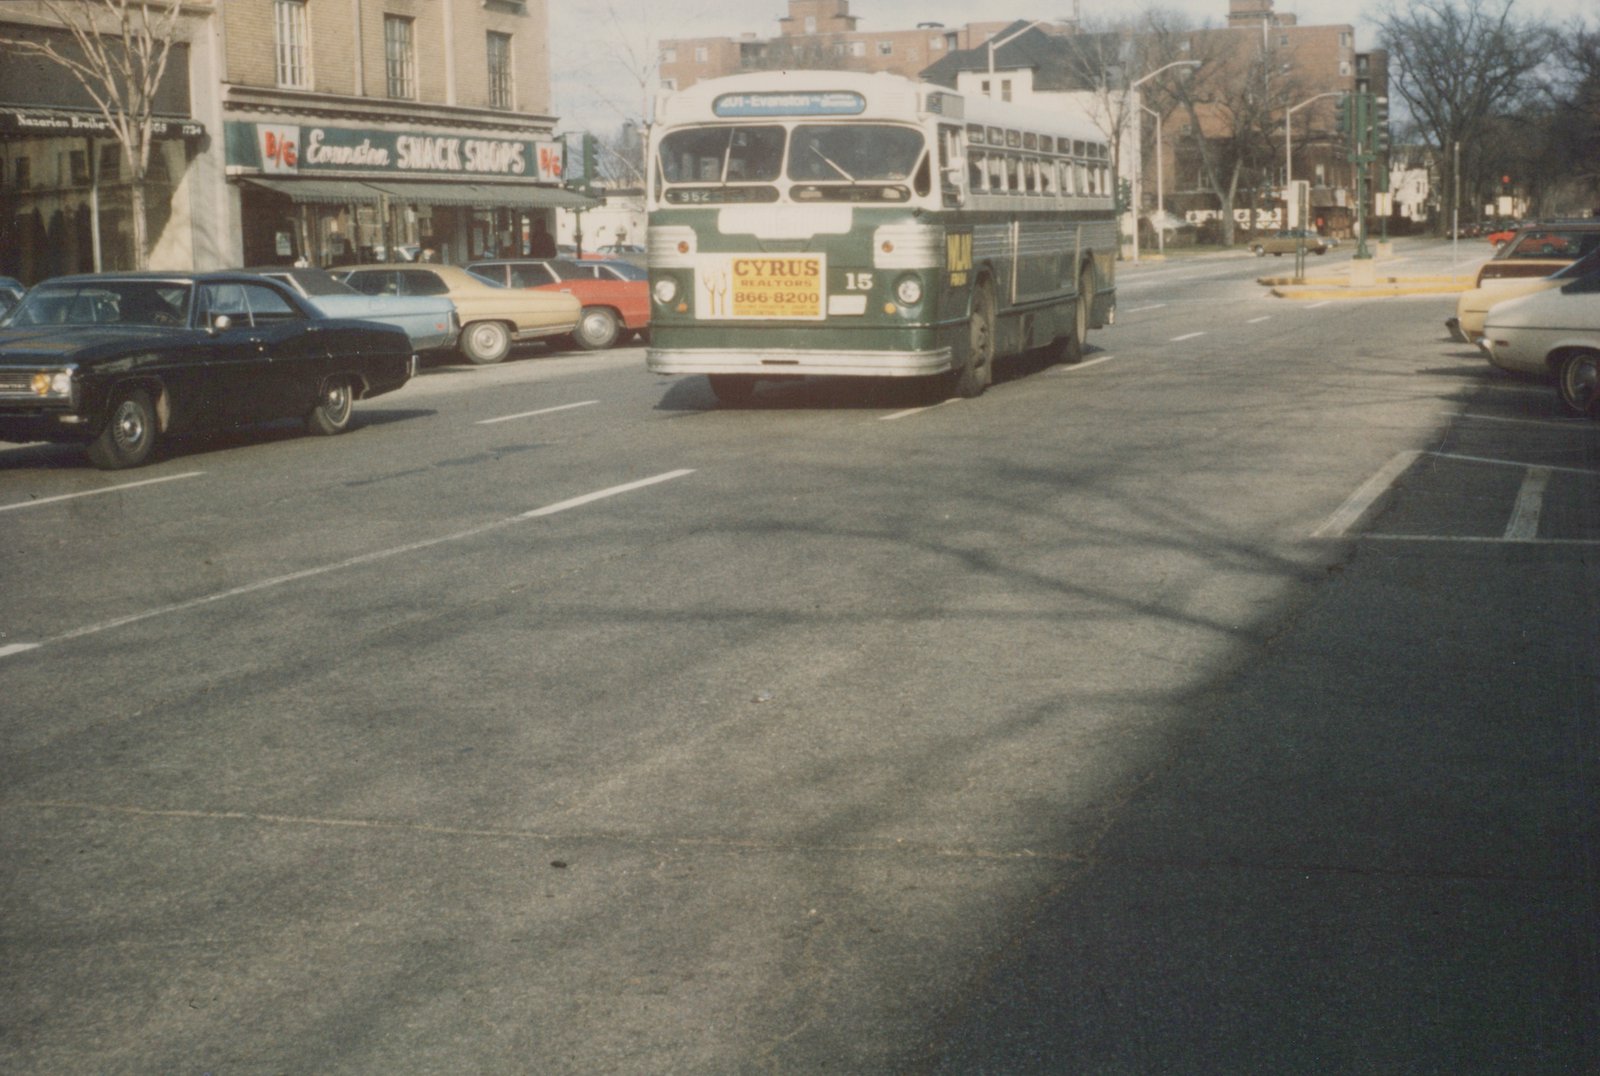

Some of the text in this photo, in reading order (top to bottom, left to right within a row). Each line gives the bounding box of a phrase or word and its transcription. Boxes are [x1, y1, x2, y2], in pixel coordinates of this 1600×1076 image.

[16, 115, 69, 128] Nazarian
[306, 128, 525, 174] Evanston SNACK SHOPS
[734, 259, 819, 277] CYRUS
[740, 279, 813, 288] REALTORS
[846, 273, 873, 290] 15
[734, 292, 820, 303] 866-8200
